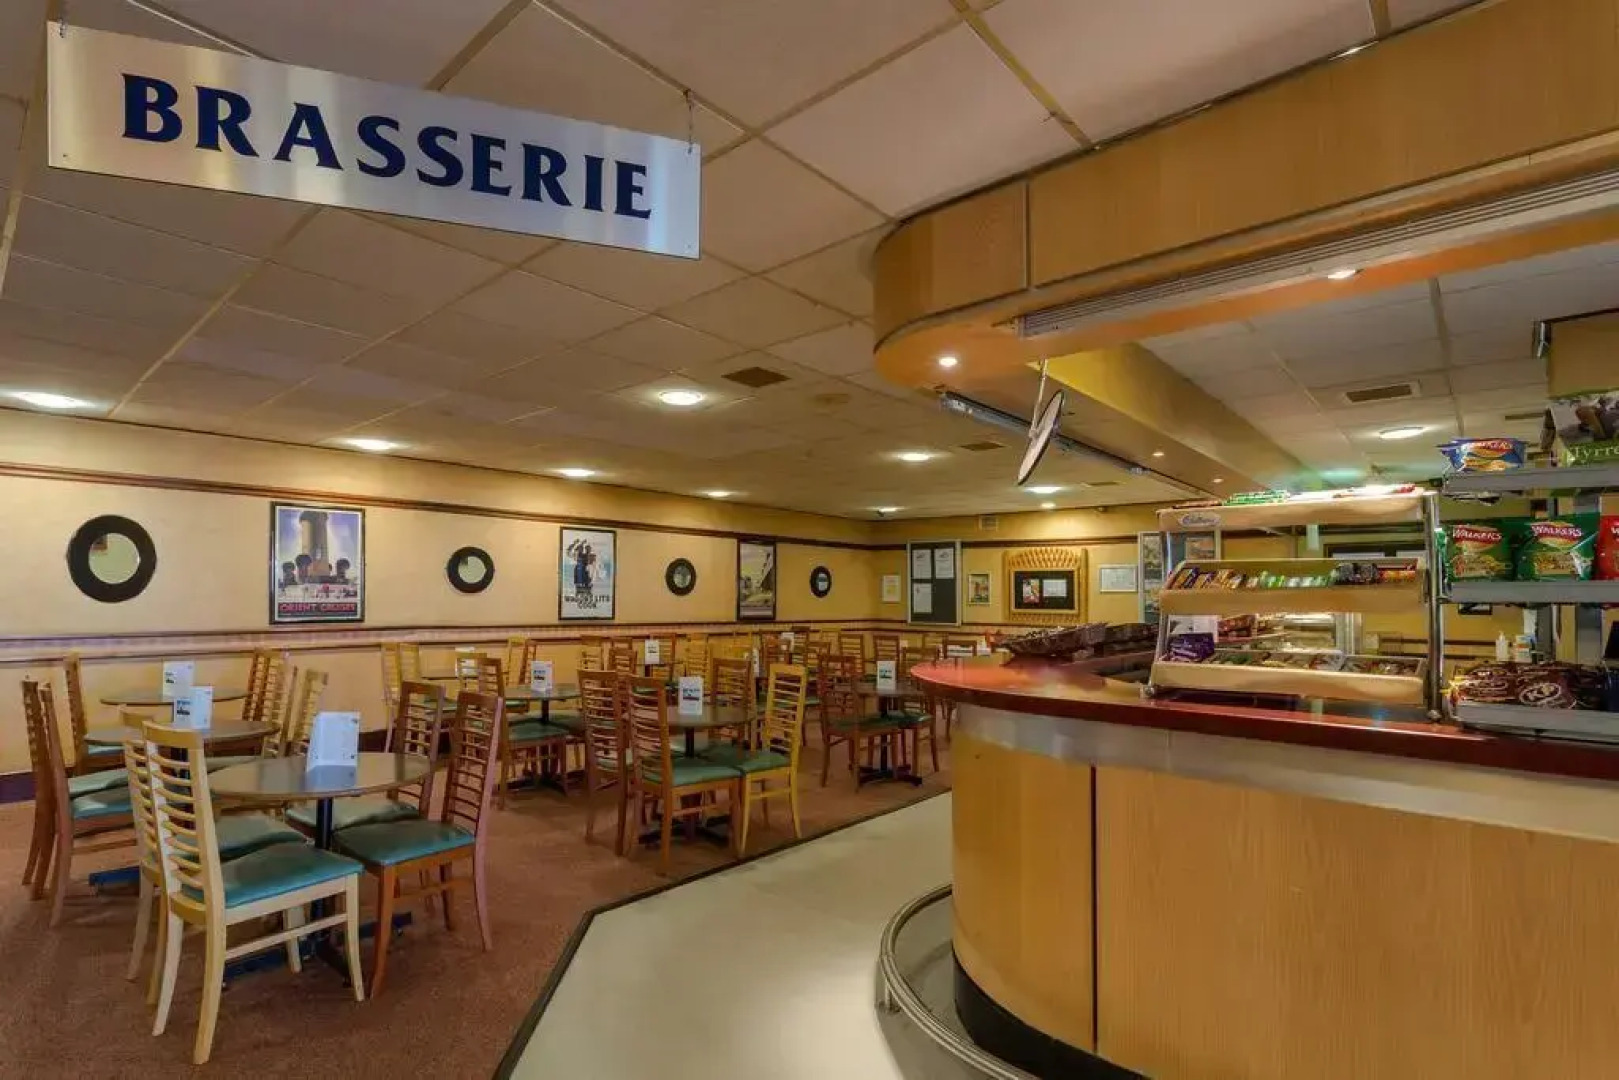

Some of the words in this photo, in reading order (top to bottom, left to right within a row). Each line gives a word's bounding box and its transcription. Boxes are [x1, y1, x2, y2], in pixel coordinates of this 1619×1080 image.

[122, 73, 652, 219] BRASSERIE
[1452, 526, 1502, 541] WALKERS
[1532, 524, 1582, 538] WALKERS
